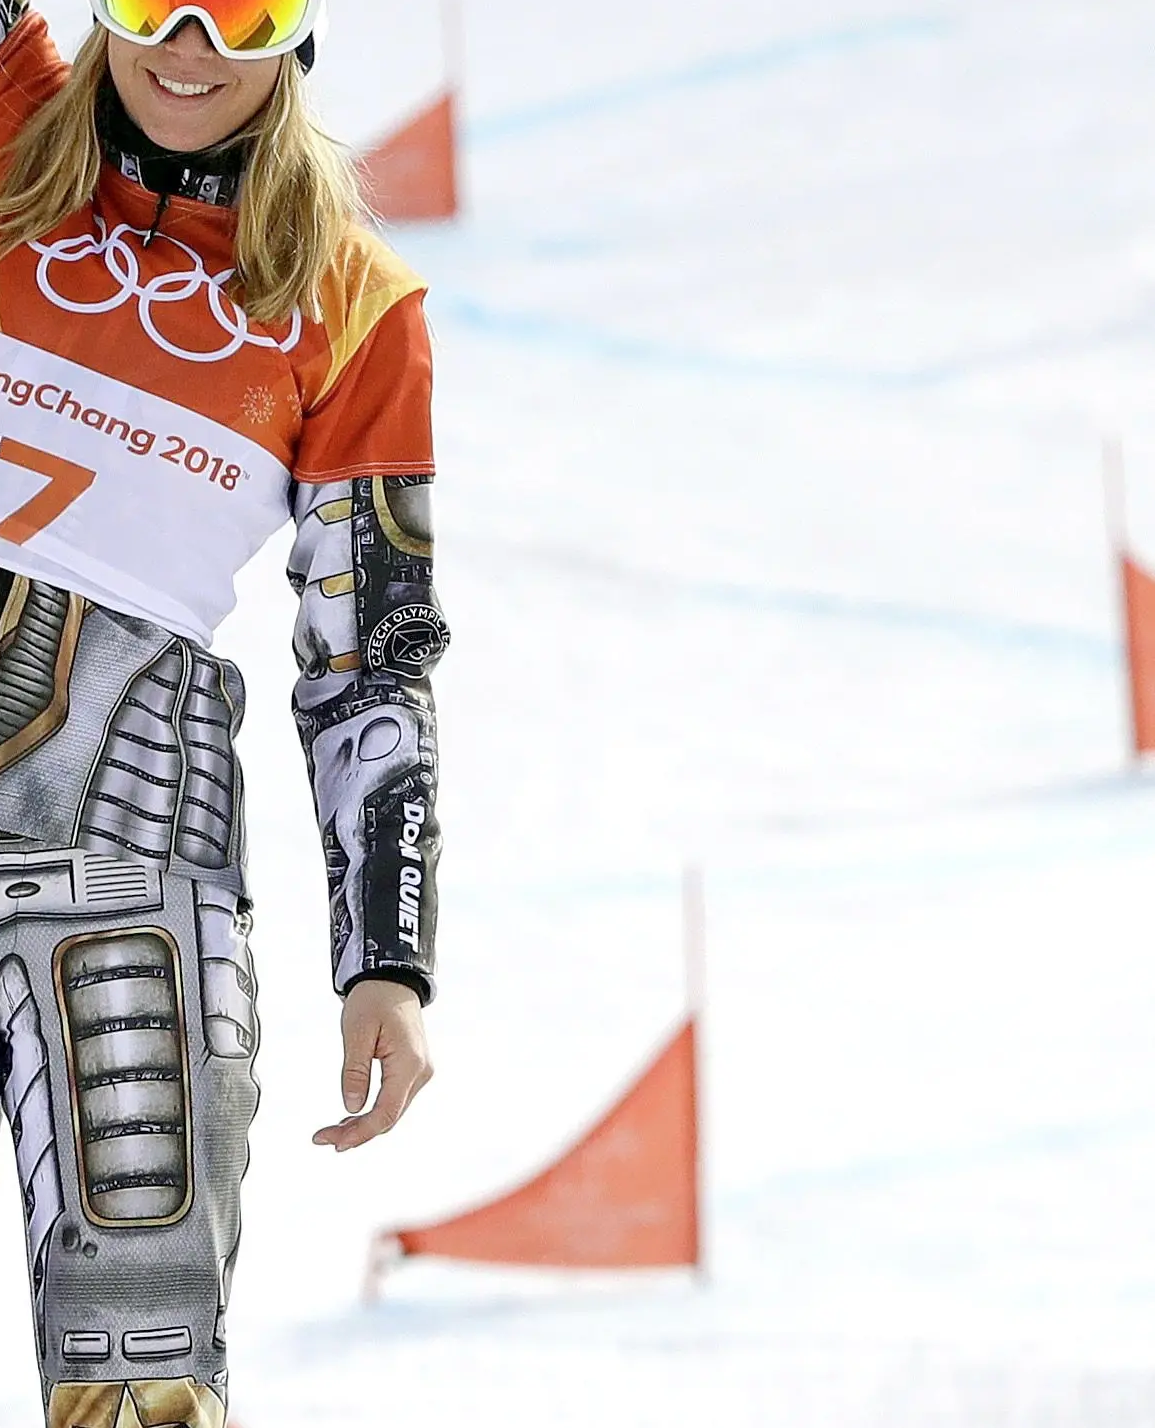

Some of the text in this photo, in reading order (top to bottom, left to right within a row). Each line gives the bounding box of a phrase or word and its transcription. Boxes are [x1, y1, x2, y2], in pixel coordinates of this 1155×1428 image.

[158, 435, 241, 491] 2018
[371, 620, 393, 667] CZECH
[393, 607, 442, 629] OLYMPIC
[397, 801, 426, 954] DON QUIET
